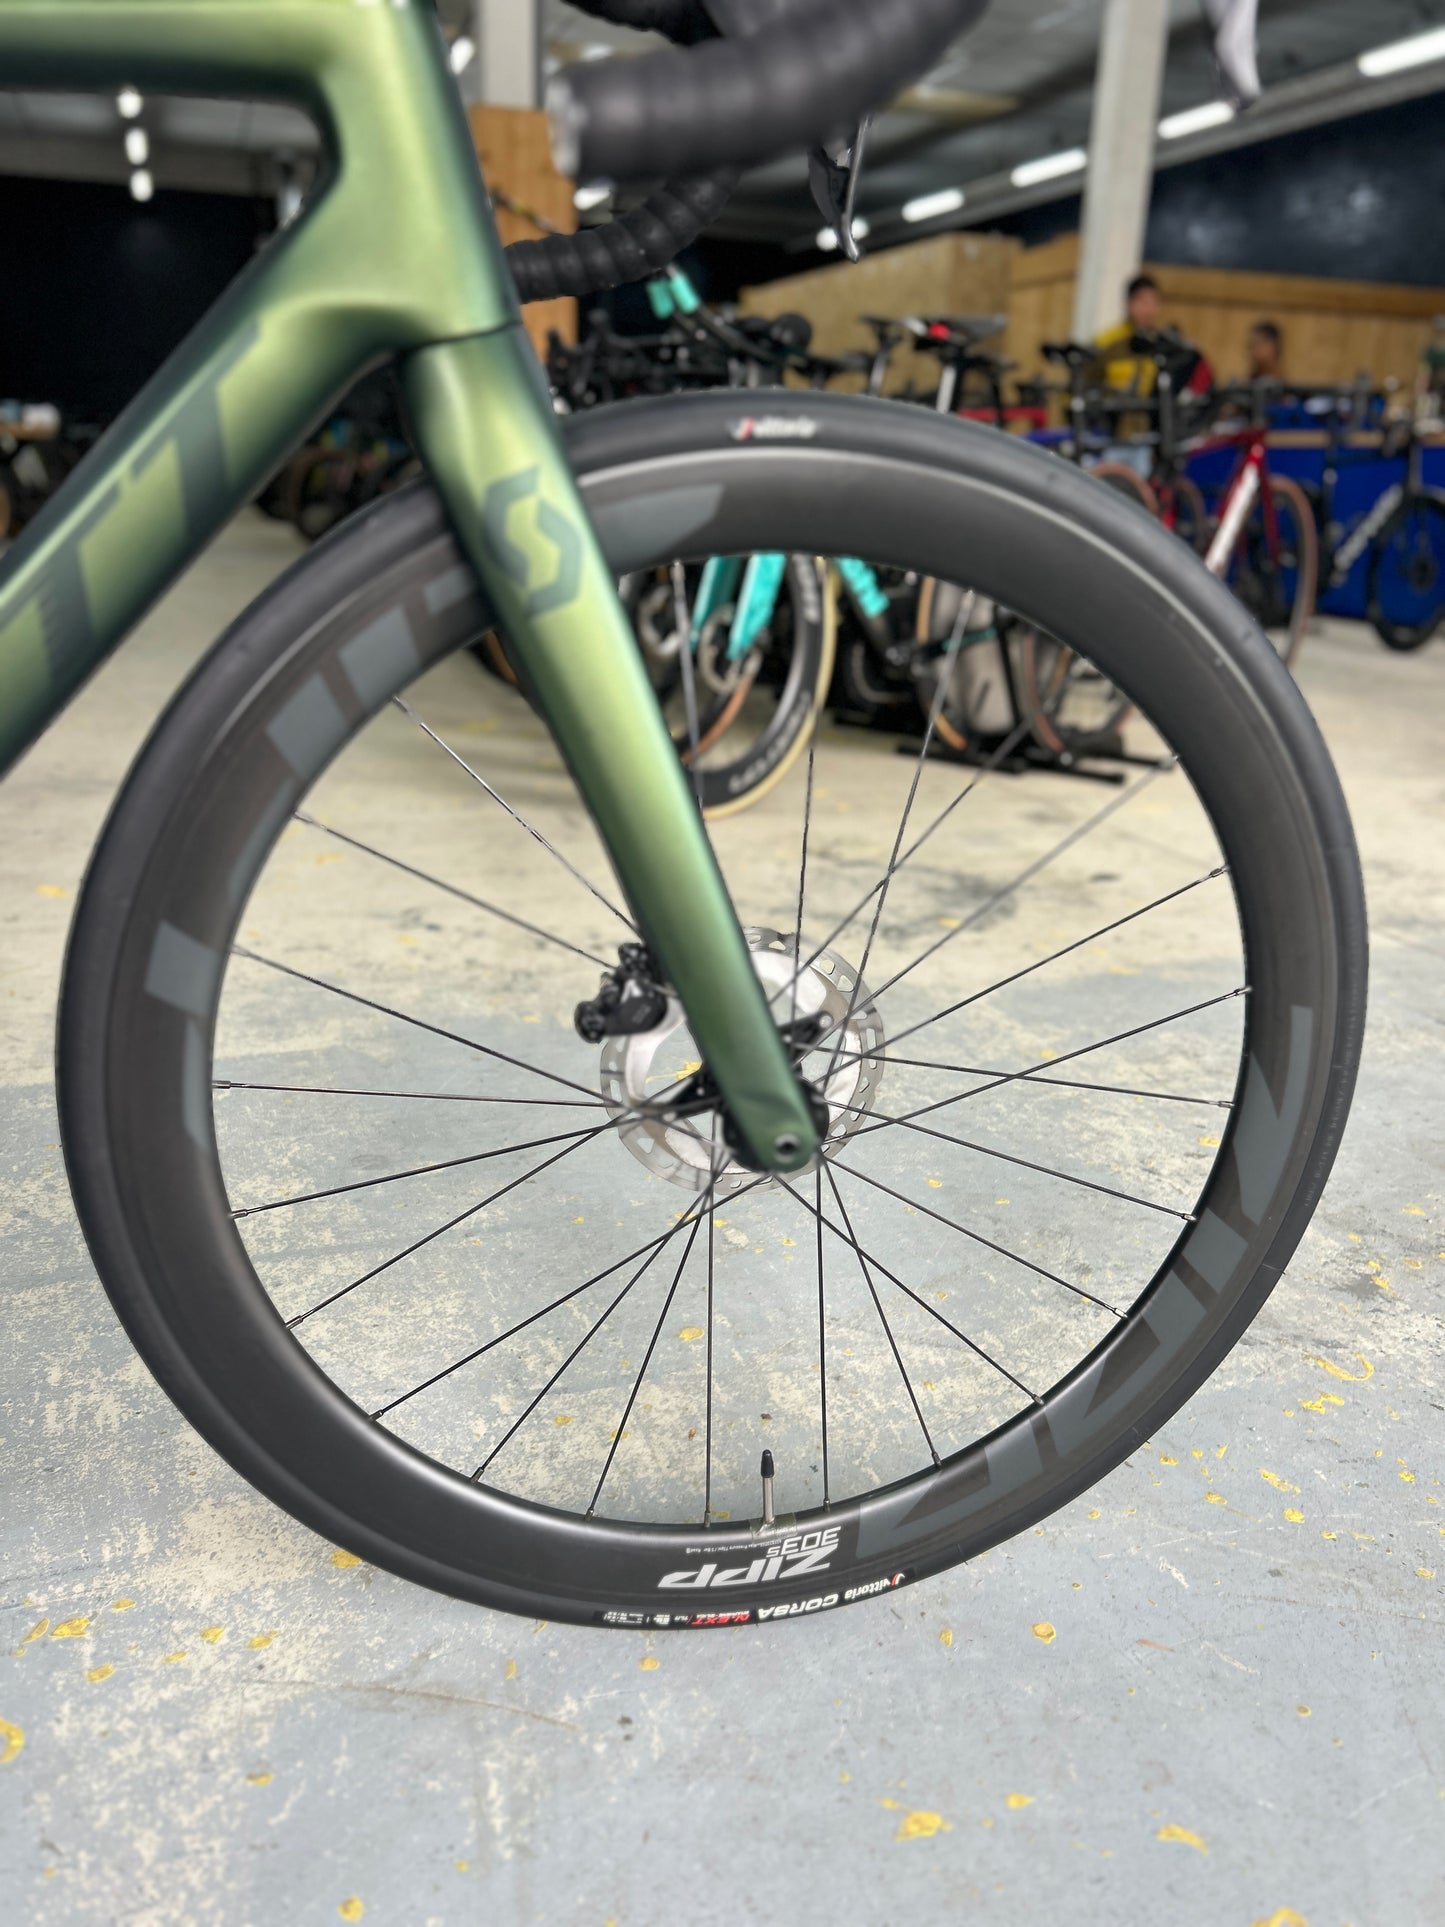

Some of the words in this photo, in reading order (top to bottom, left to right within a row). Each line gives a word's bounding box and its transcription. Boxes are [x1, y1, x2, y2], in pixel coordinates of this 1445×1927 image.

[657, 1543, 838, 1588] ZIPP
[844, 1577, 891, 1600] vittoria
[758, 1593, 839, 1620] CORSA
